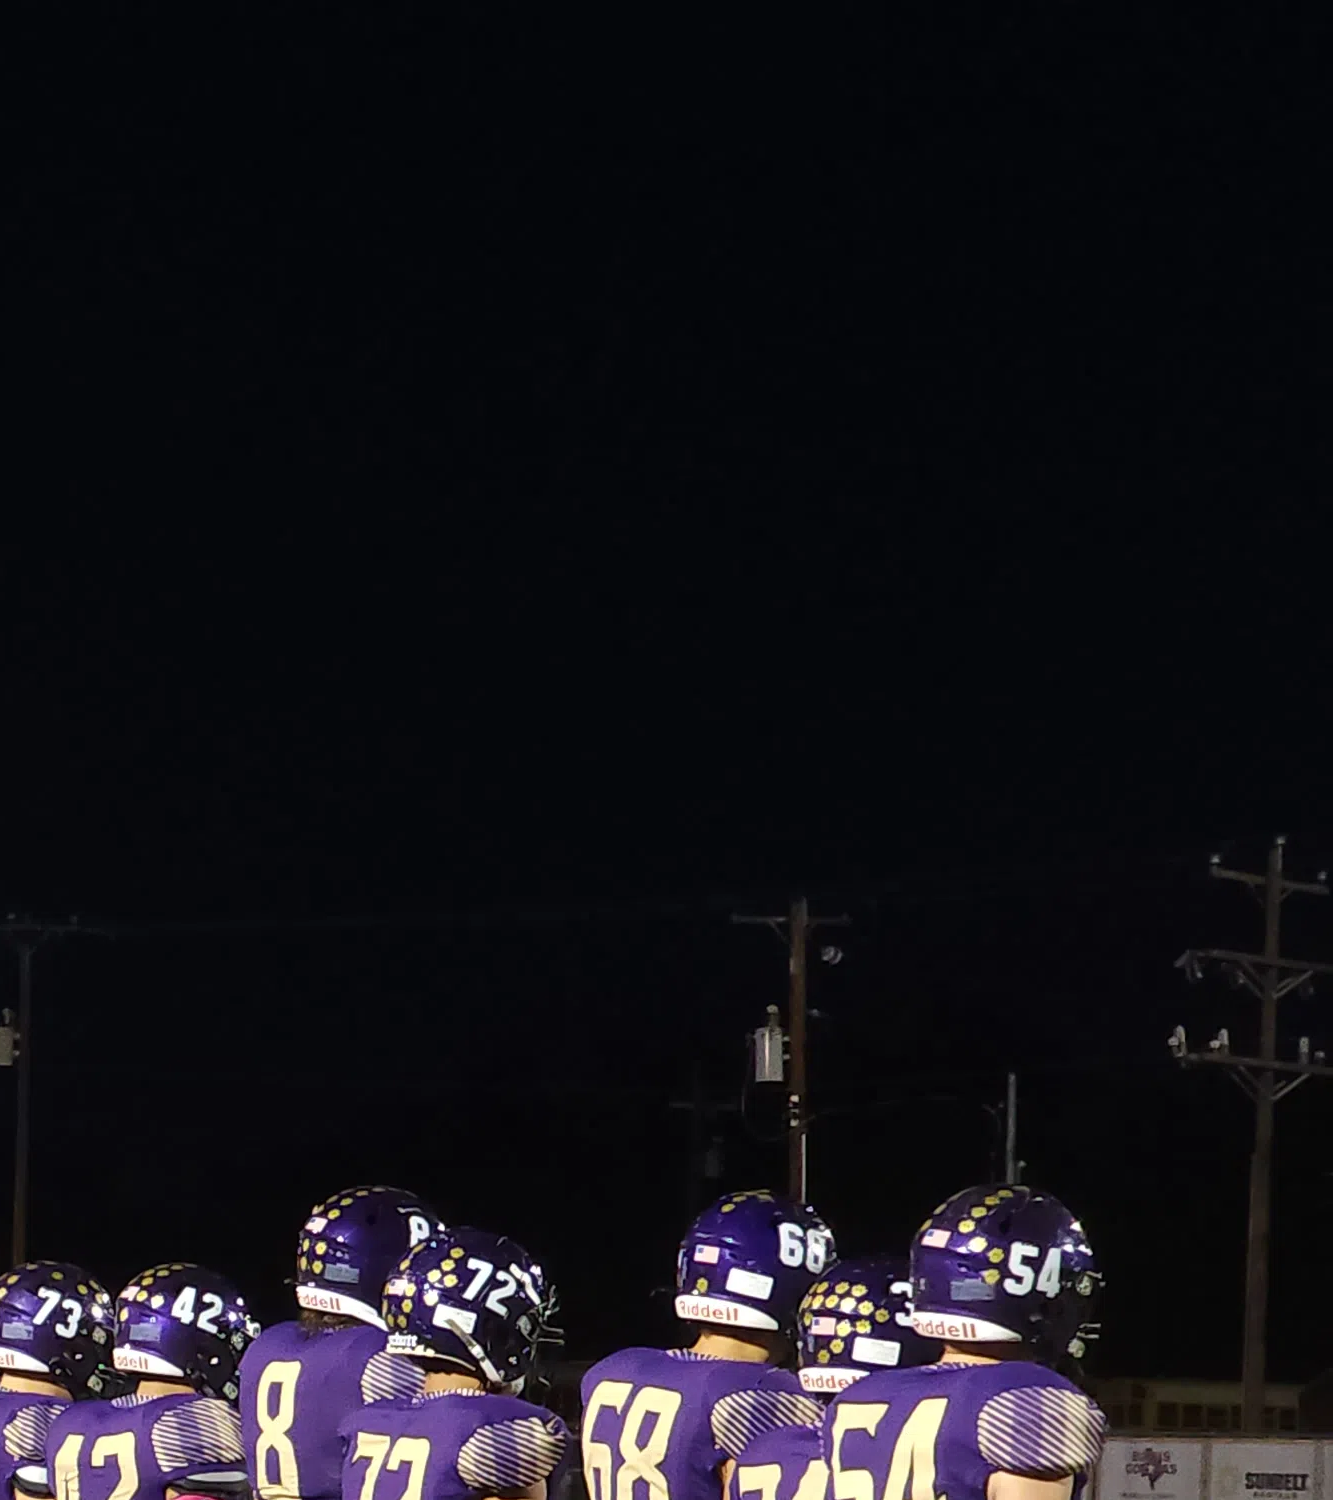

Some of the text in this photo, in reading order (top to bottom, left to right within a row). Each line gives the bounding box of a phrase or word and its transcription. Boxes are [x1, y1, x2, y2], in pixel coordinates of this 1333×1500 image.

[777, 1221, 826, 1274] 68
[1003, 1241, 1062, 1299] 54
[32, 1286, 82, 1339] 73
[170, 1286, 223, 1334] 42
[459, 1257, 518, 1319] 72
[679, 1300, 739, 1321] Riddell
